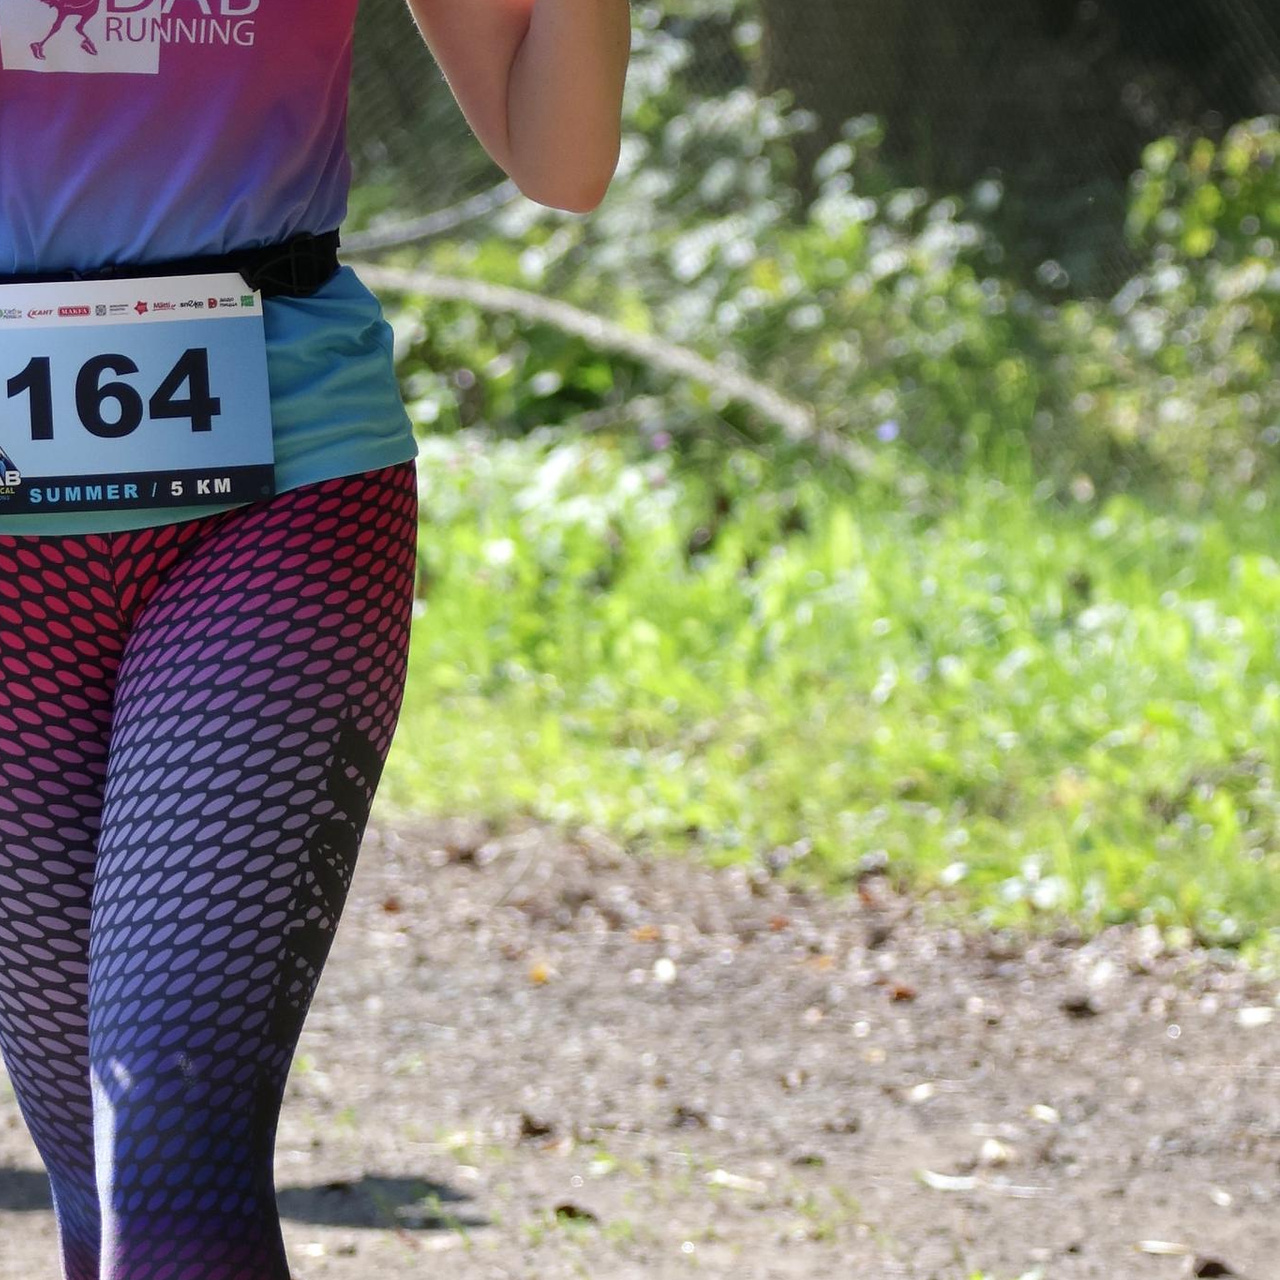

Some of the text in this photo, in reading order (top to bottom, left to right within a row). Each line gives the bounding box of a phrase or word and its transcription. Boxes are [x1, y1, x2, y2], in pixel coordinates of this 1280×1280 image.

[105, 17, 255, 46] RUNNING
[7, 348, 221, 440] 164
[29, 483, 139, 503] SUMMER
[171, 481, 183, 496] 5
[197, 478, 232, 495] KM
